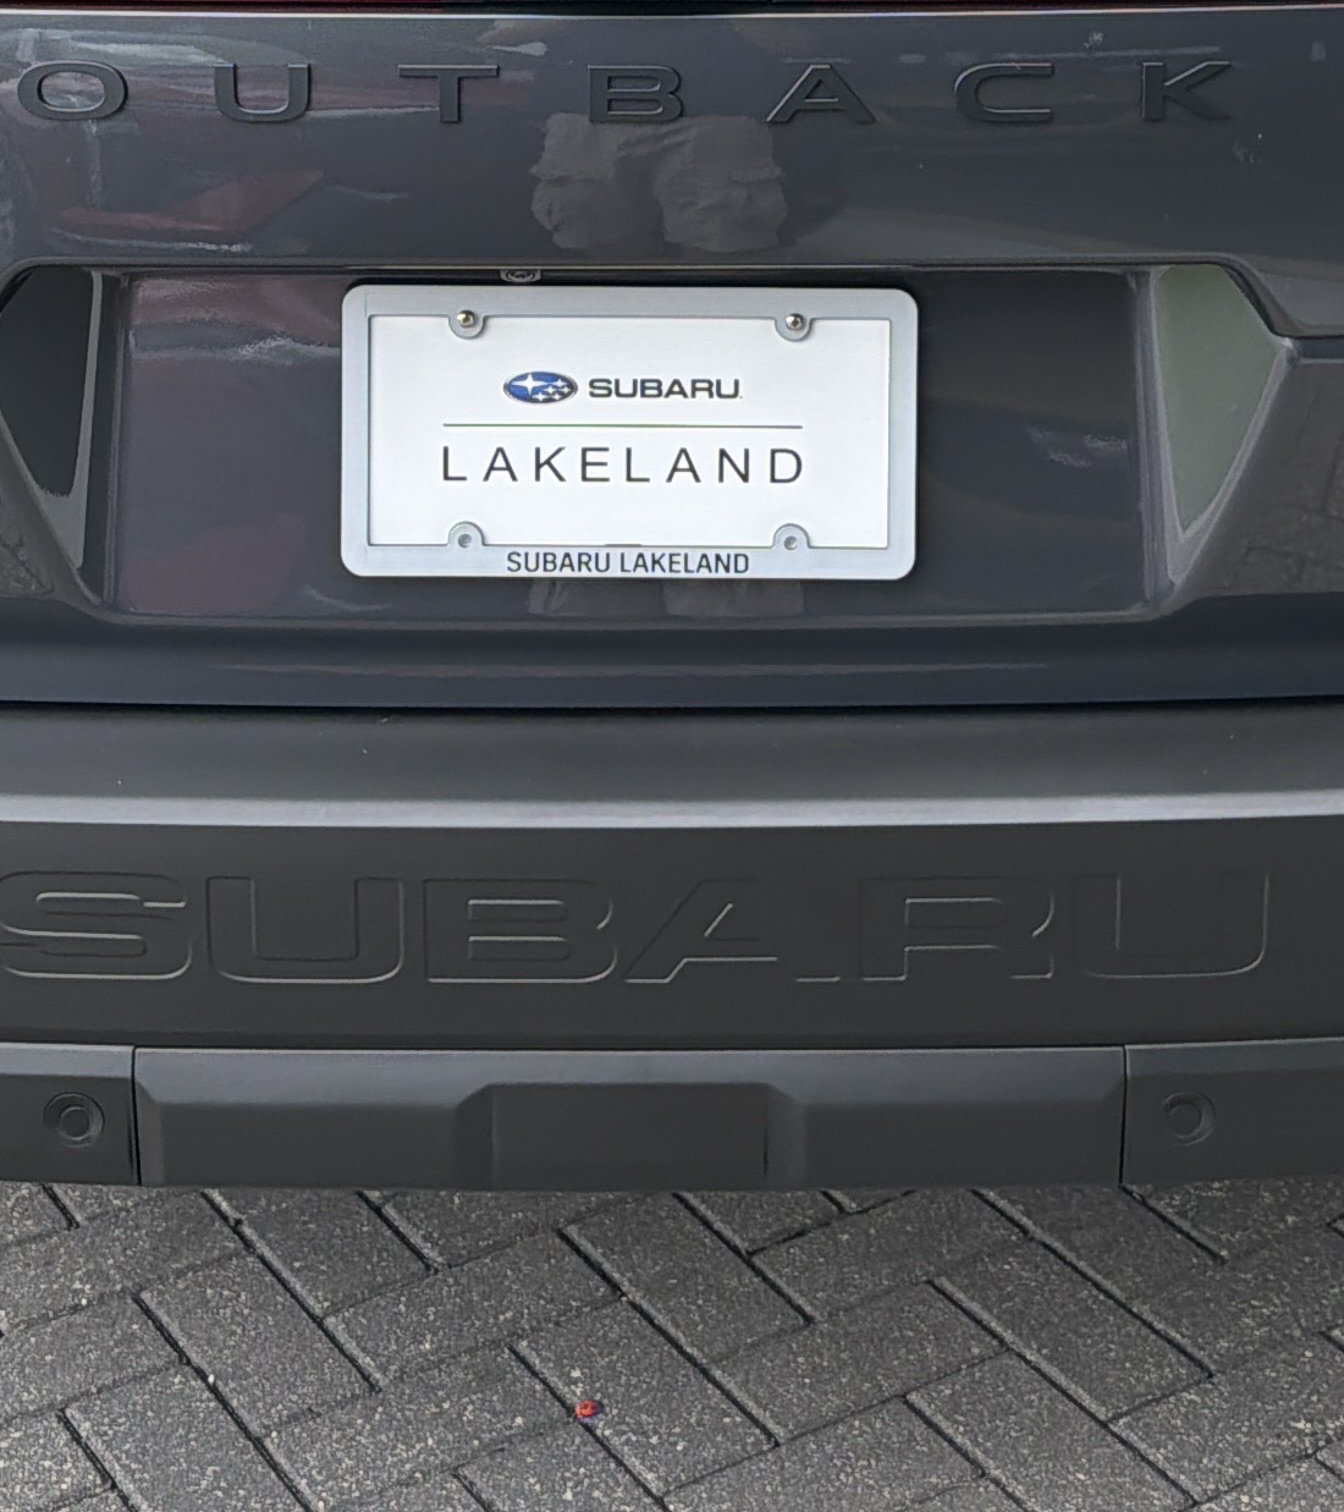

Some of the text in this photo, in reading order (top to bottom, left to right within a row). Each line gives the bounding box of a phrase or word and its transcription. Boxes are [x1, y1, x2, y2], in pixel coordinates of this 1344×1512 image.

[16, 58, 1233, 125] OUTBACK
[588, 376, 741, 400] SUBARU
[442, 445, 803, 484] LAKELAND
[506, 551, 751, 576] SUBARU LAKELAND
